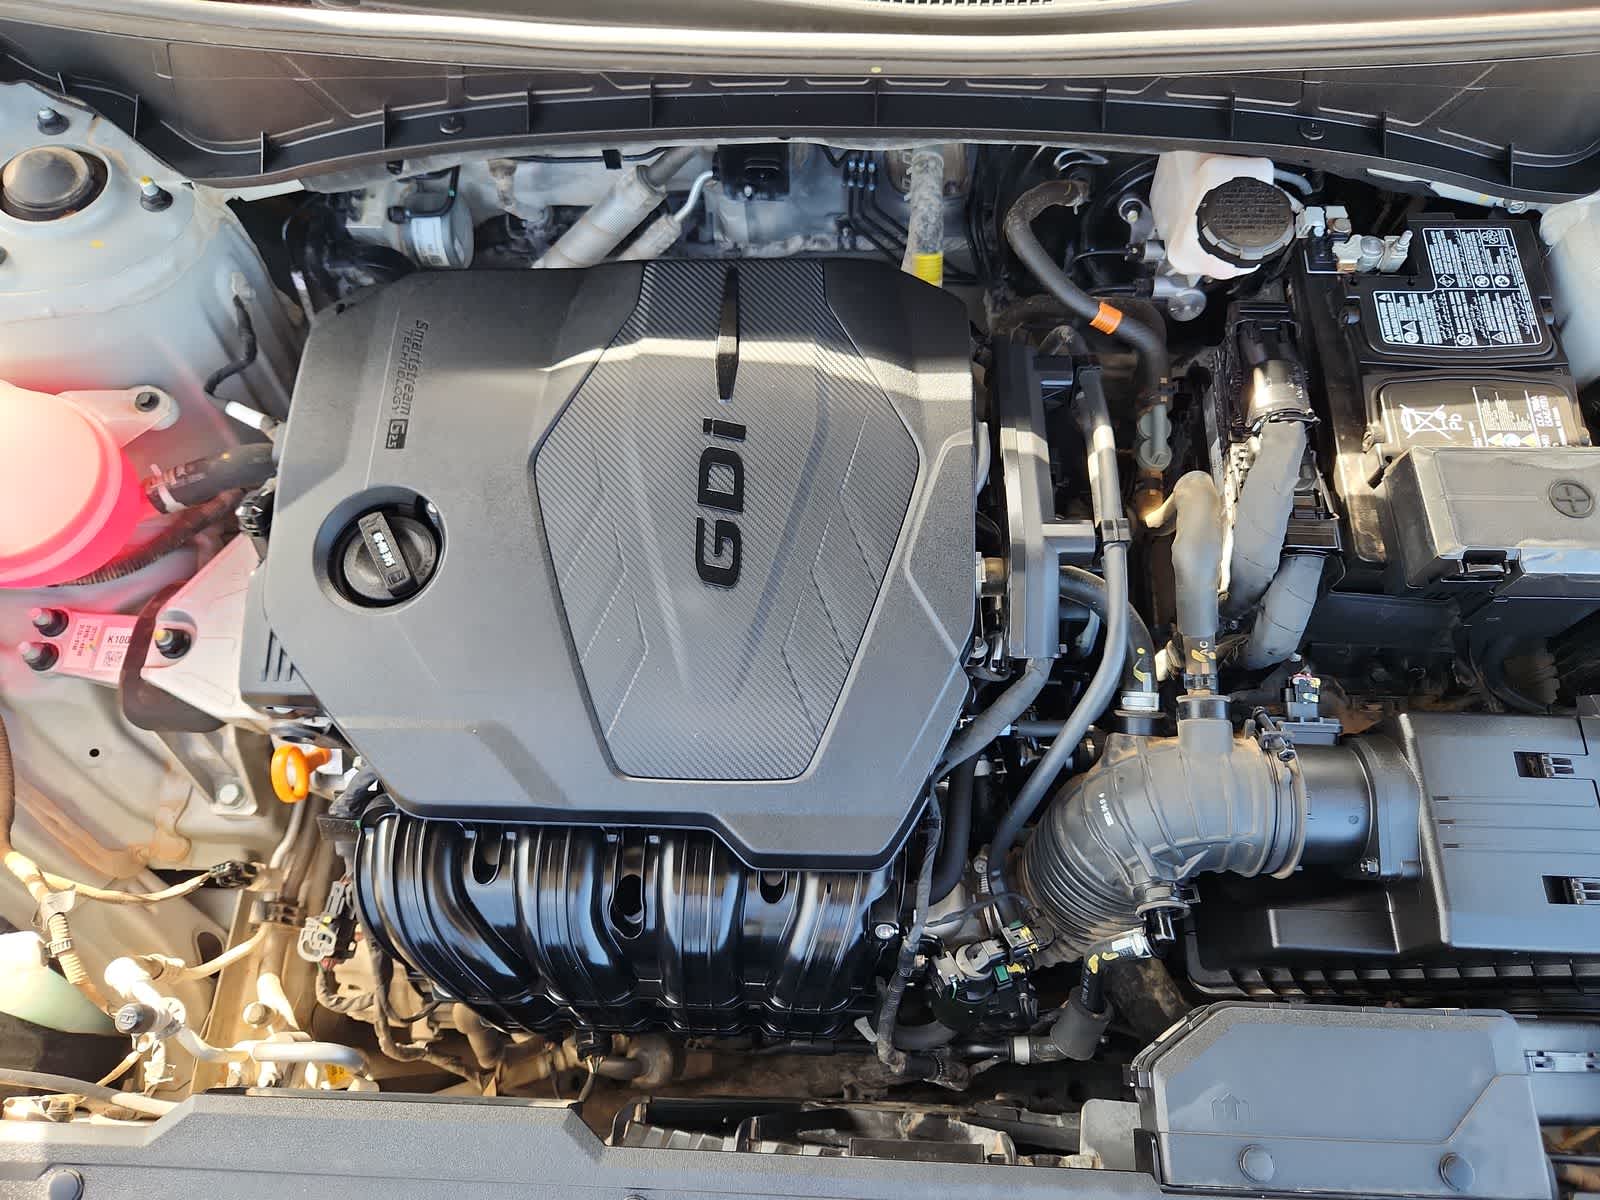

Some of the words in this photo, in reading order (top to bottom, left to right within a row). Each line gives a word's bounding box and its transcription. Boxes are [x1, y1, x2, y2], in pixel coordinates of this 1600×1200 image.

[400, 319, 430, 416] Smartstream
[1448, 412, 1464, 431] Pb
[694, 416, 746, 590] GDi
